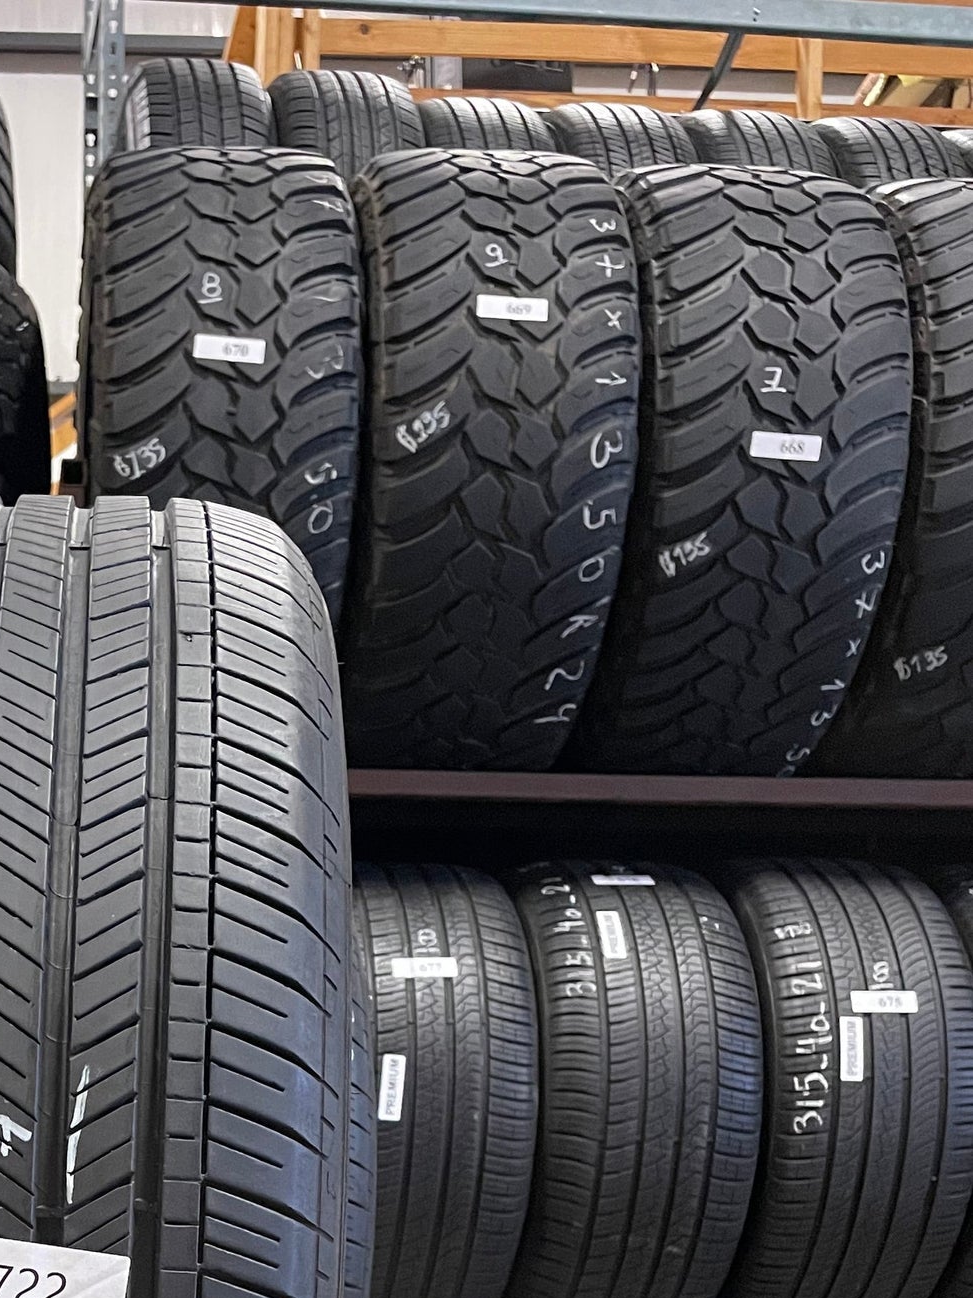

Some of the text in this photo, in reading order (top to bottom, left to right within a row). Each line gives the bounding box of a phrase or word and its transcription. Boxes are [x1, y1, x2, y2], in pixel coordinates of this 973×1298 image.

[200, 271, 223, 298] 8
[791, 960, 833, 1134] 315-40-21
[846, 1020, 858, 1076] PREMIUM
[385, 1057, 400, 1116] PREMIUM
